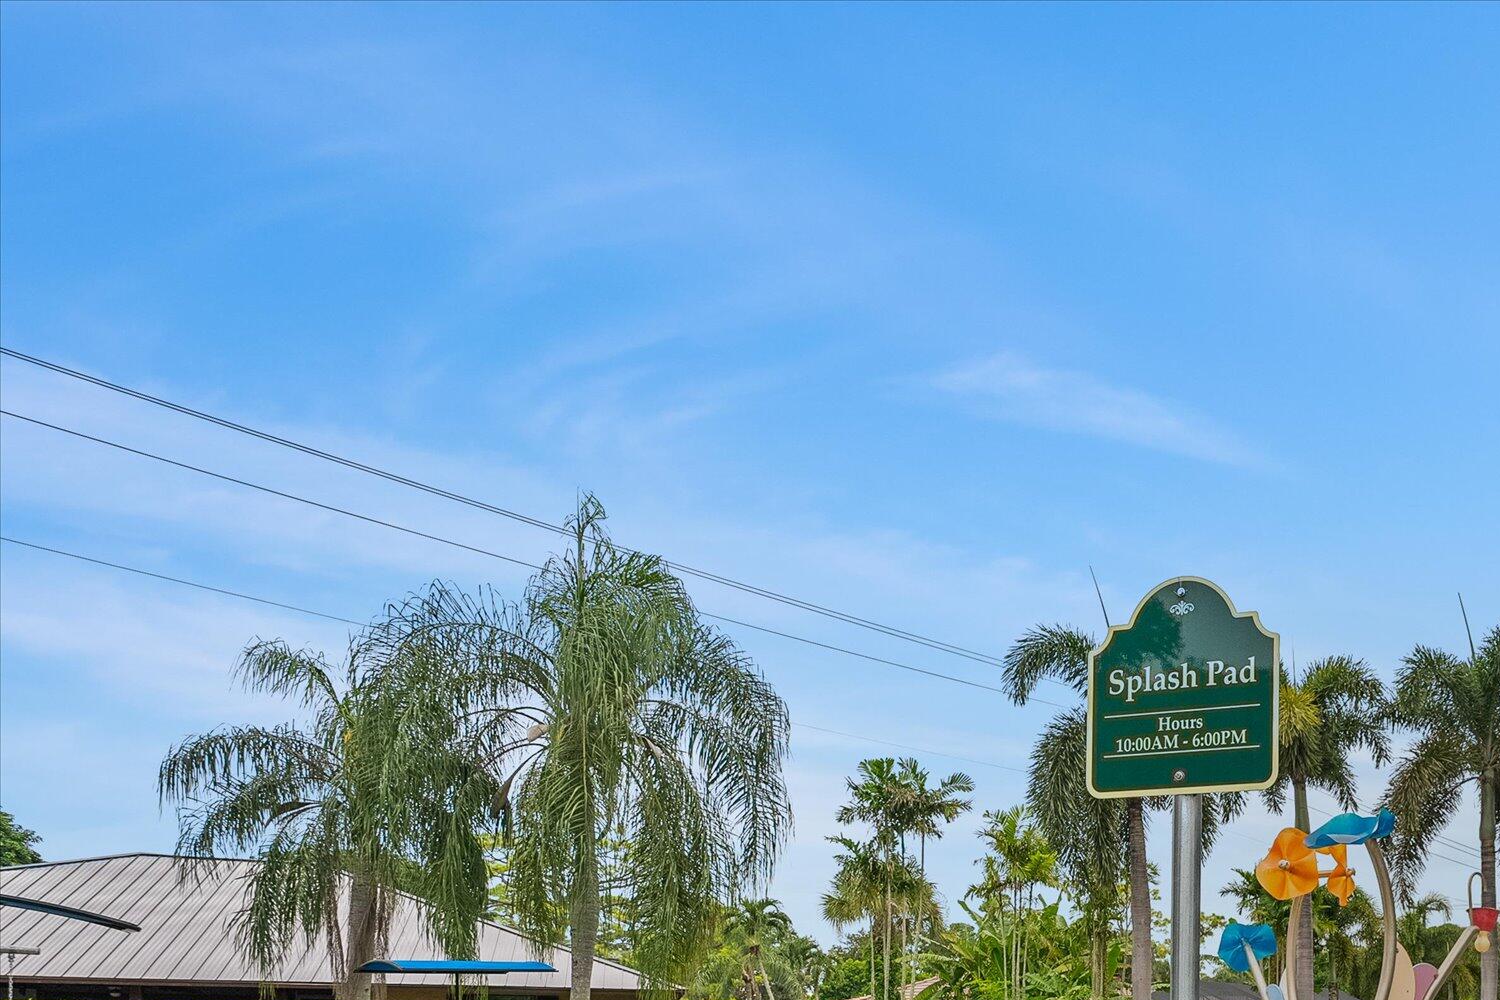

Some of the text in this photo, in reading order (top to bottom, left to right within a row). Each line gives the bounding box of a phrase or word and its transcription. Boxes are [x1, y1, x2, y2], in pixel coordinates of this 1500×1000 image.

[1109, 656, 1257, 702] Splash Pad
[1157, 716, 1203, 732] Hours
[1116, 734, 1179, 753] 10:00AM
[1192, 729, 1247, 747] 6:00PM
